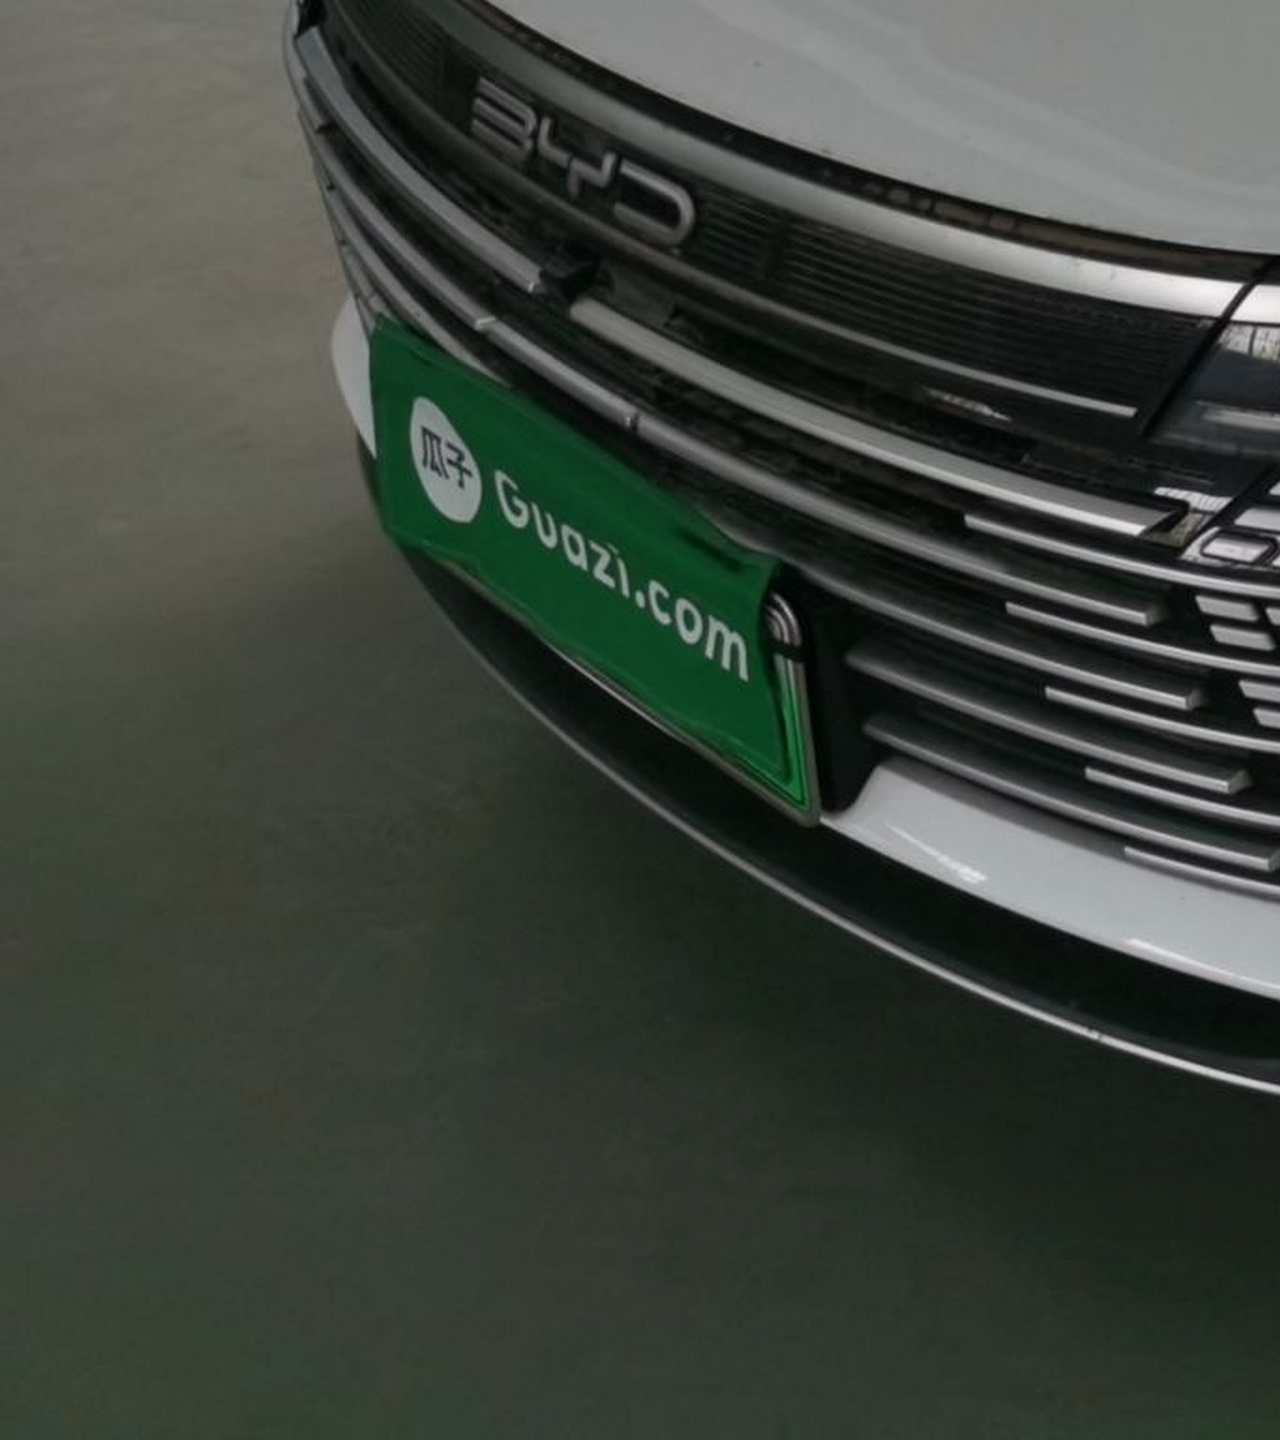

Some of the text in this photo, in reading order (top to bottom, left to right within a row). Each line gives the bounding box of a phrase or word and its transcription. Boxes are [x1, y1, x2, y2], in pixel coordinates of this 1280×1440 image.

[470, 76, 696, 248] BYD
[420, 425, 473, 489] 瓜子
[494, 470, 750, 682] Guazi.com
